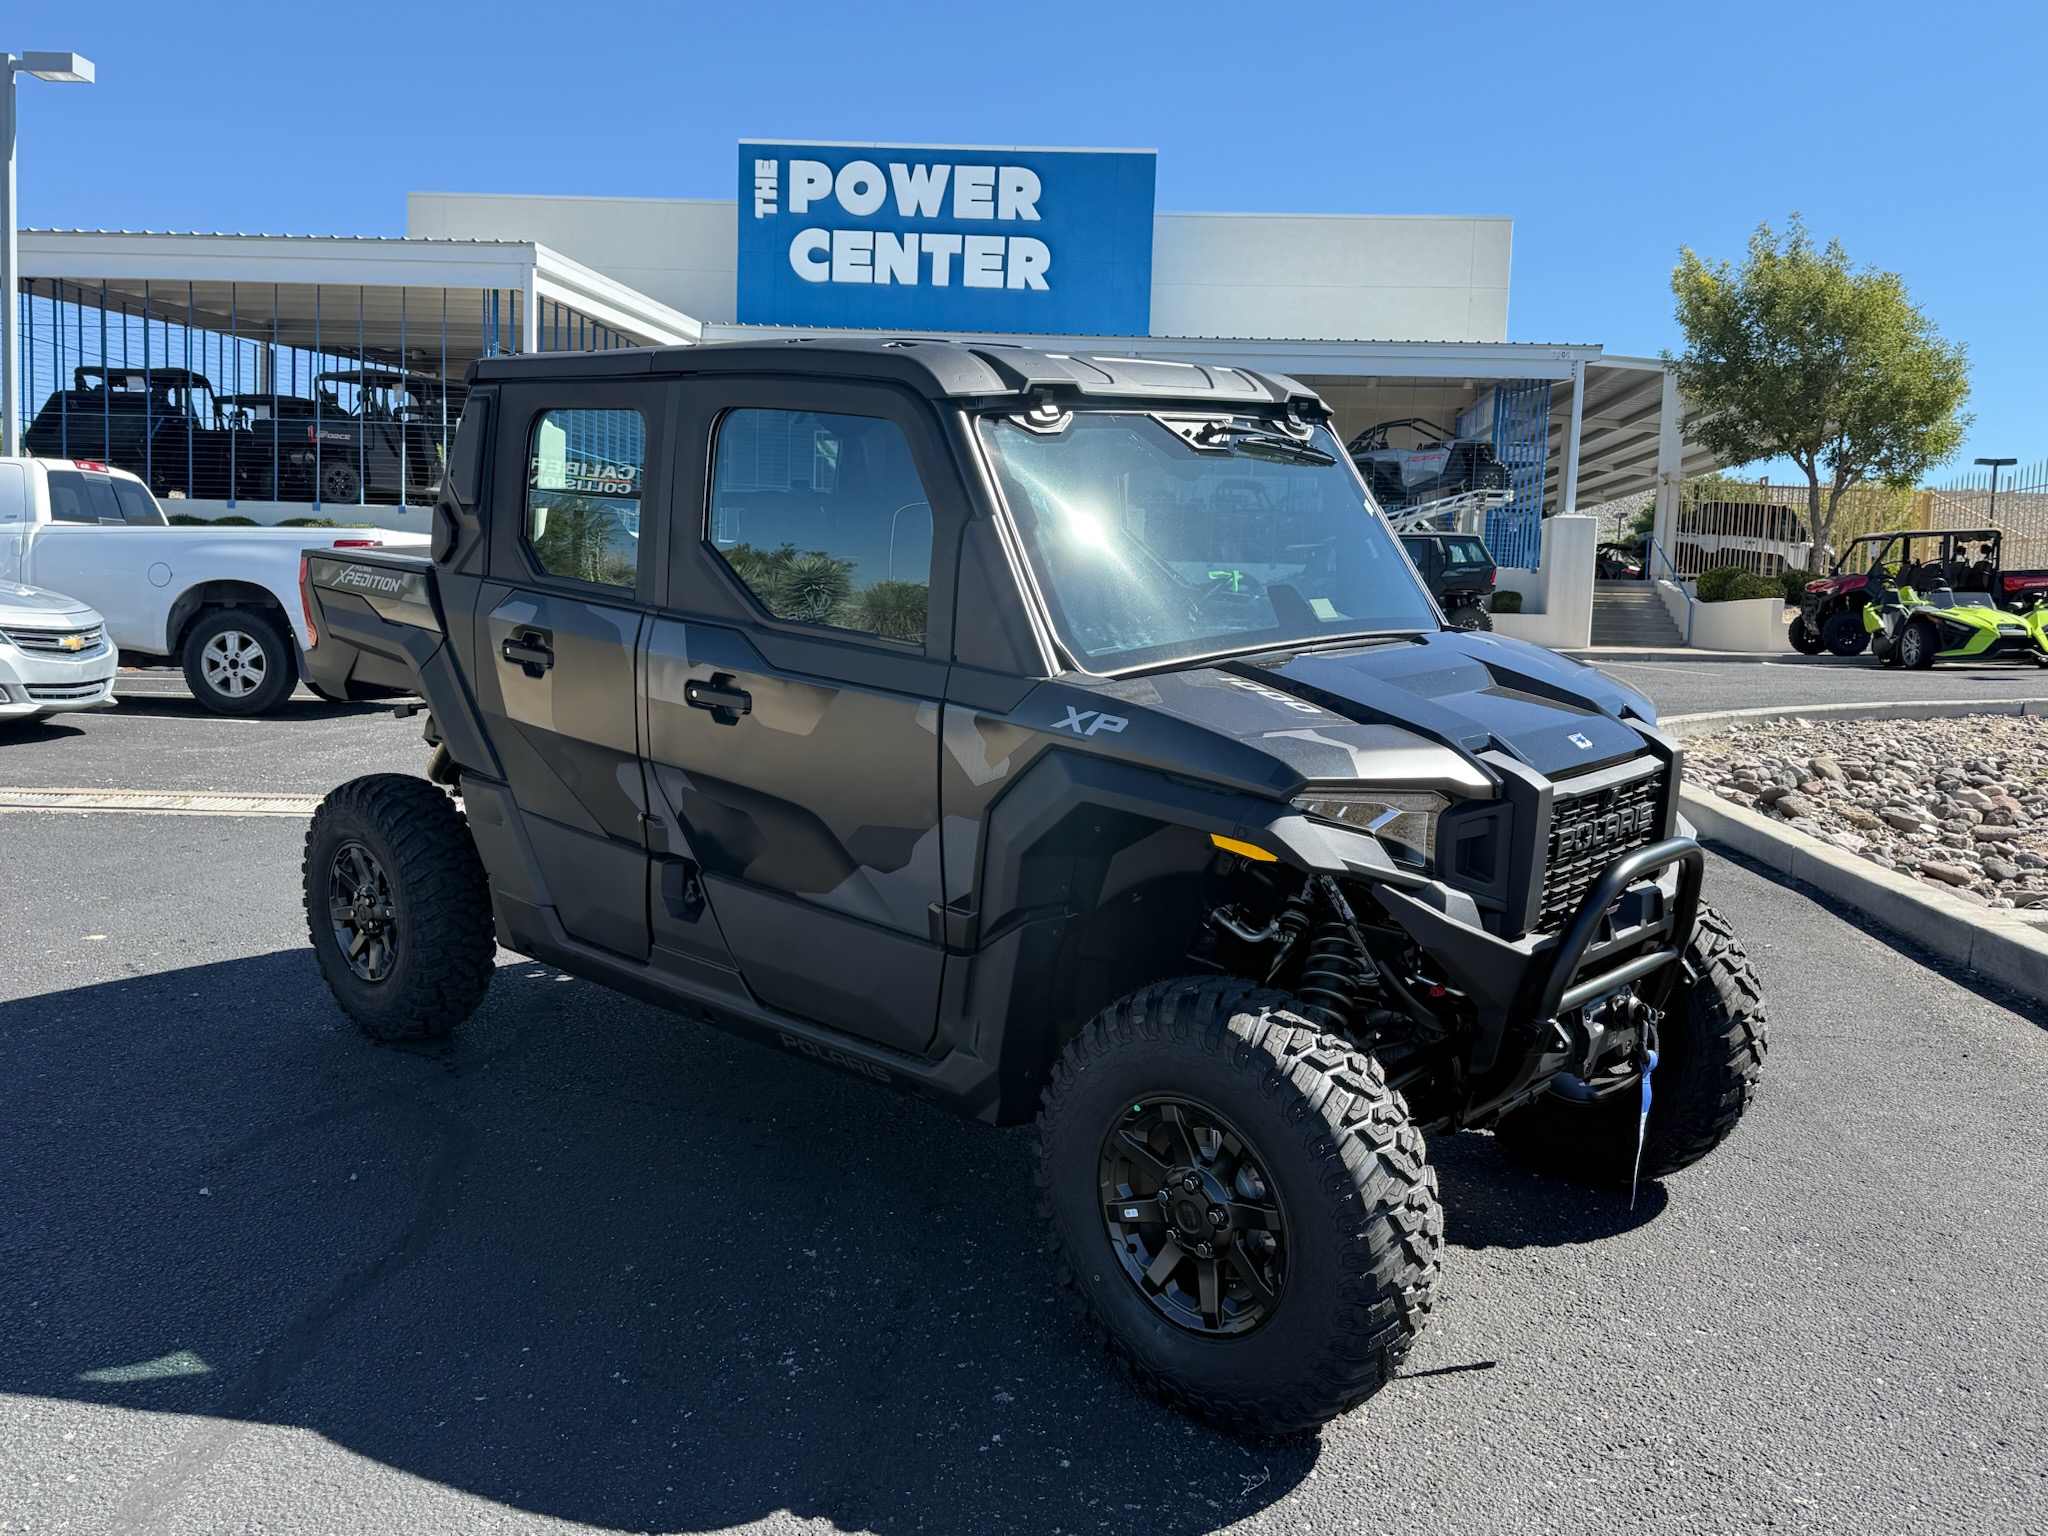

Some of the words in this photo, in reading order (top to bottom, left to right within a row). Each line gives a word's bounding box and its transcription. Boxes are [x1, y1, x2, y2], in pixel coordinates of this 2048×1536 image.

[754, 158, 778, 219] THE
[788, 159, 1042, 221] POWER
[788, 227, 1051, 291] CENTER
[331, 564, 401, 593] XPEDITION
[1050, 705, 1129, 736] XP
[1217, 677, 1322, 713] 1000
[1553, 801, 1656, 859] POLARIS
[779, 1032, 892, 1083] POLARIS
